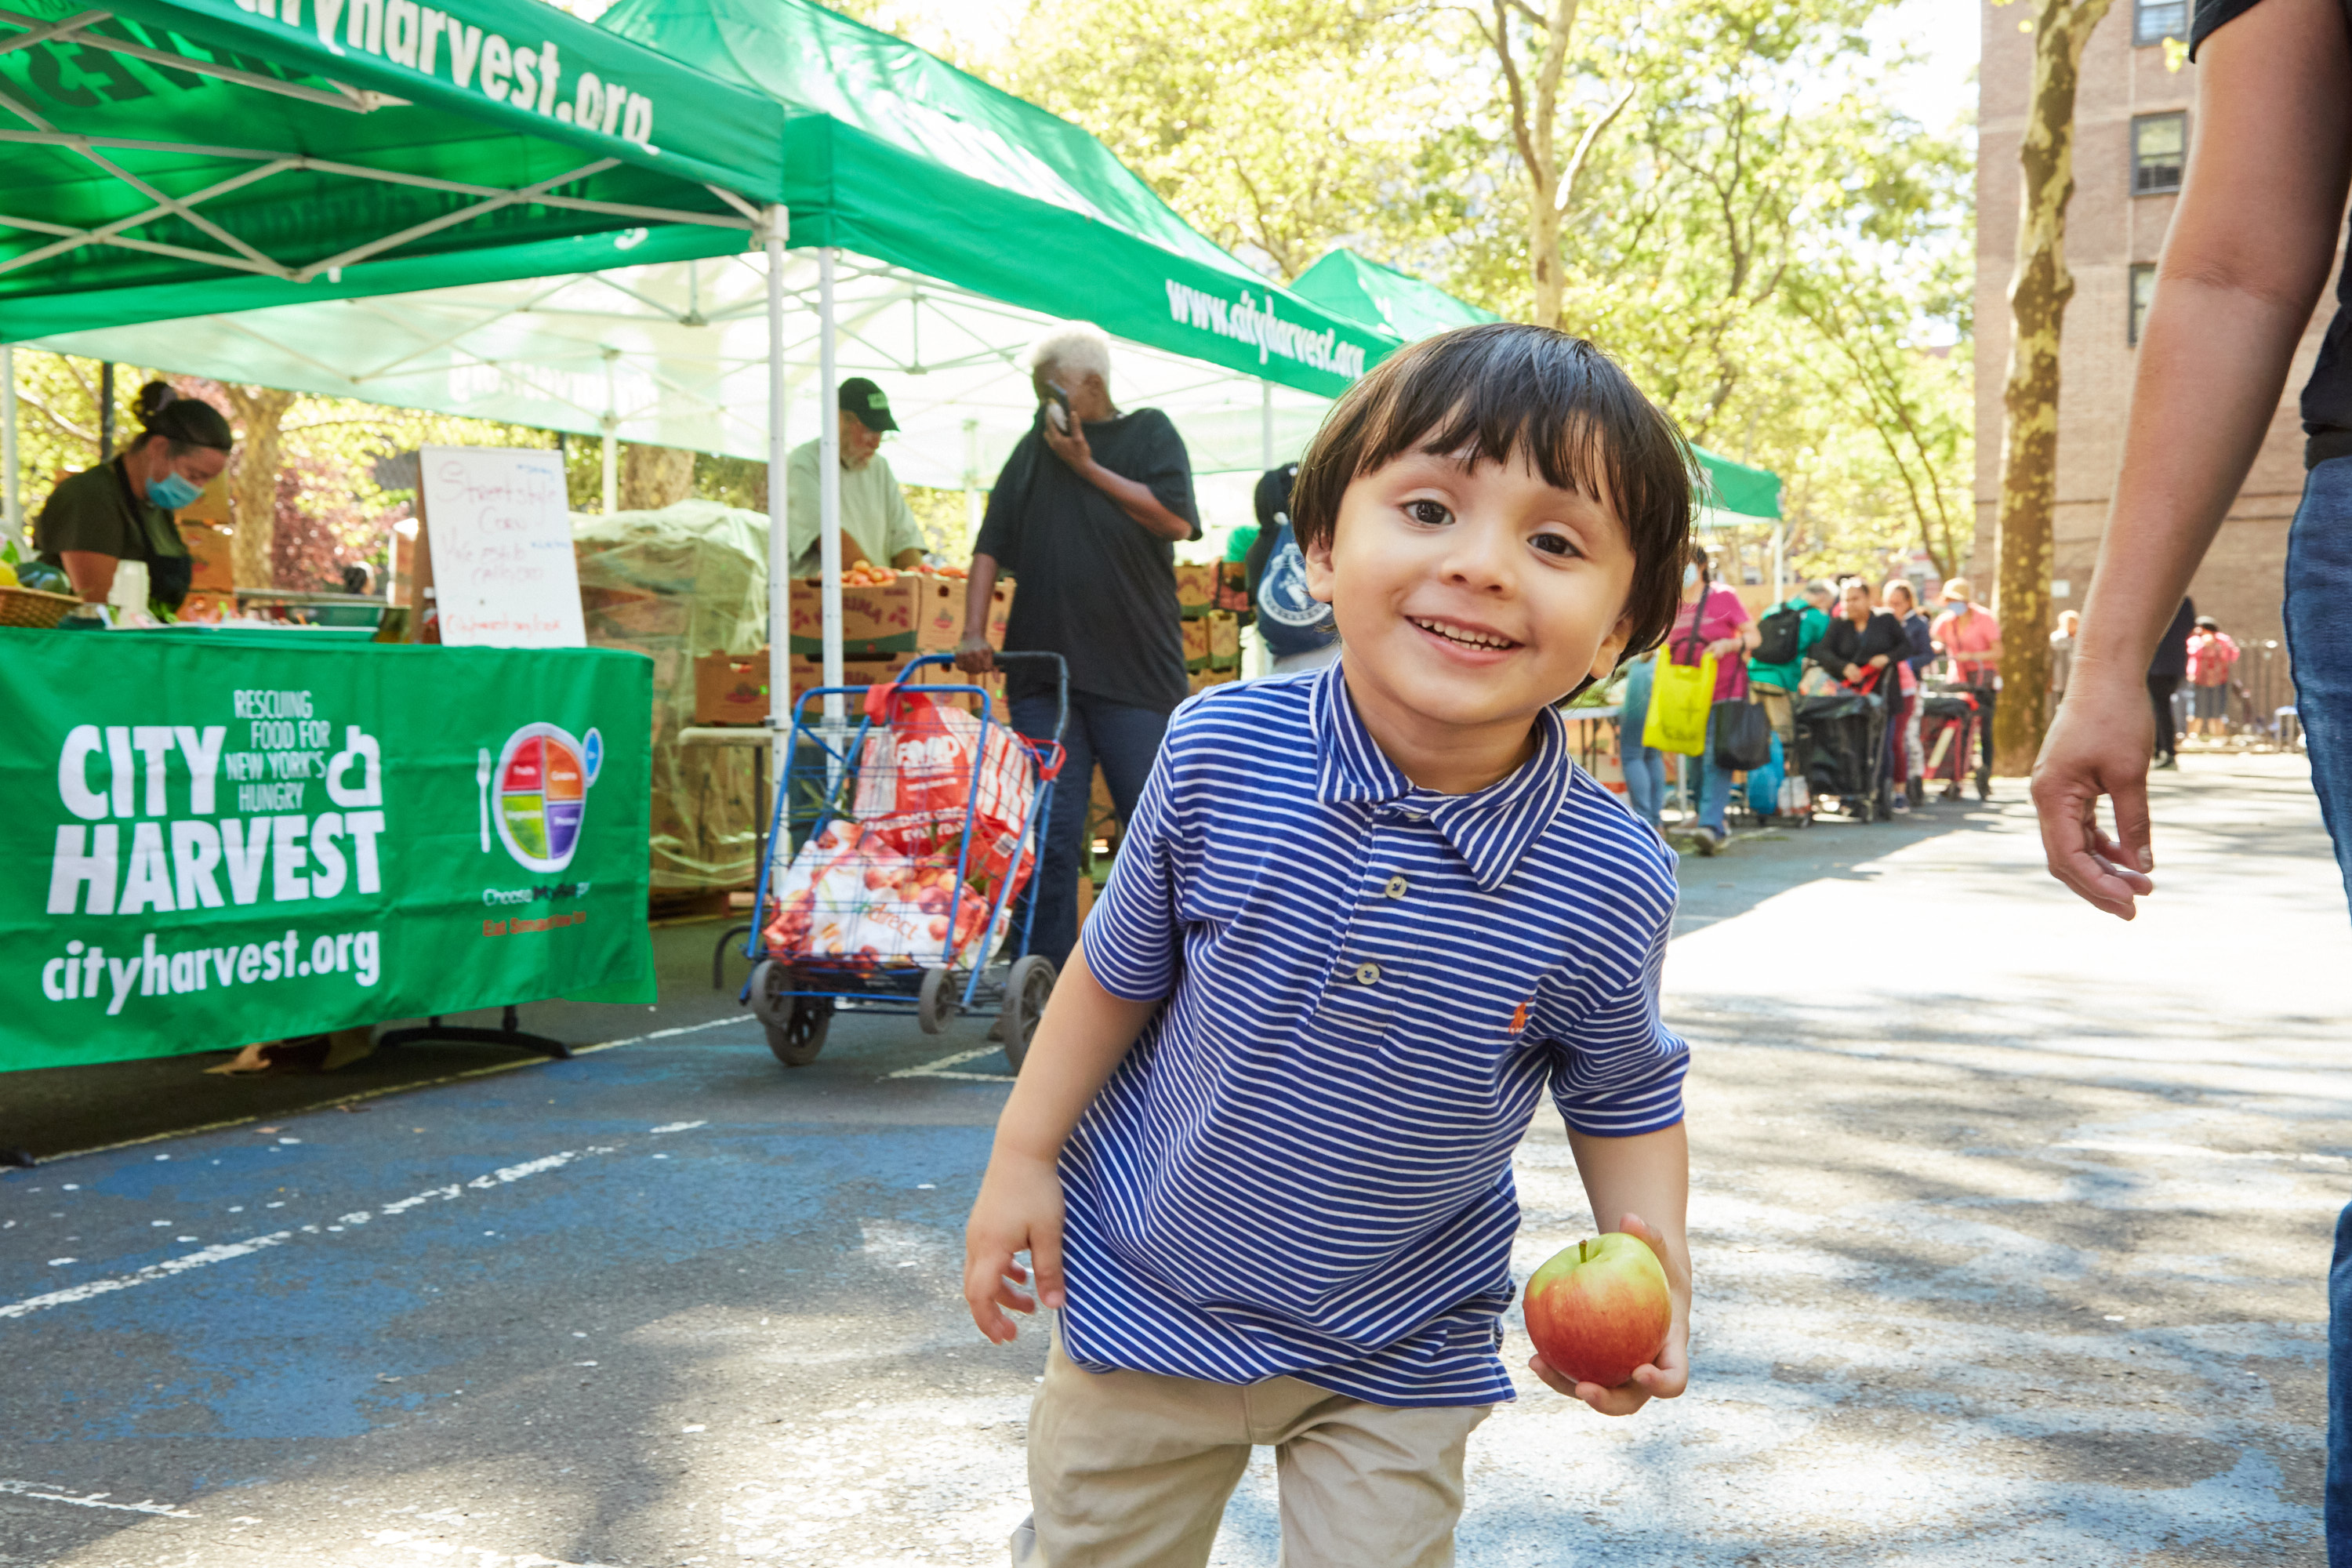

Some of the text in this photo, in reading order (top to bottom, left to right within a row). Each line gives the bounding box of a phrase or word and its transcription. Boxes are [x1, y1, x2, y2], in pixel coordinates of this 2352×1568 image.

[234, 689, 314, 720] RESCUING
[251, 720, 331, 750] FOOD FOR
[58, 724, 227, 821] CITY
[224, 750, 327, 782] NEW YORK'S
[238, 782, 305, 812] HUNGRY
[46, 810, 386, 916] HARVEST
[42, 929, 380, 1016] cityharvest.org
